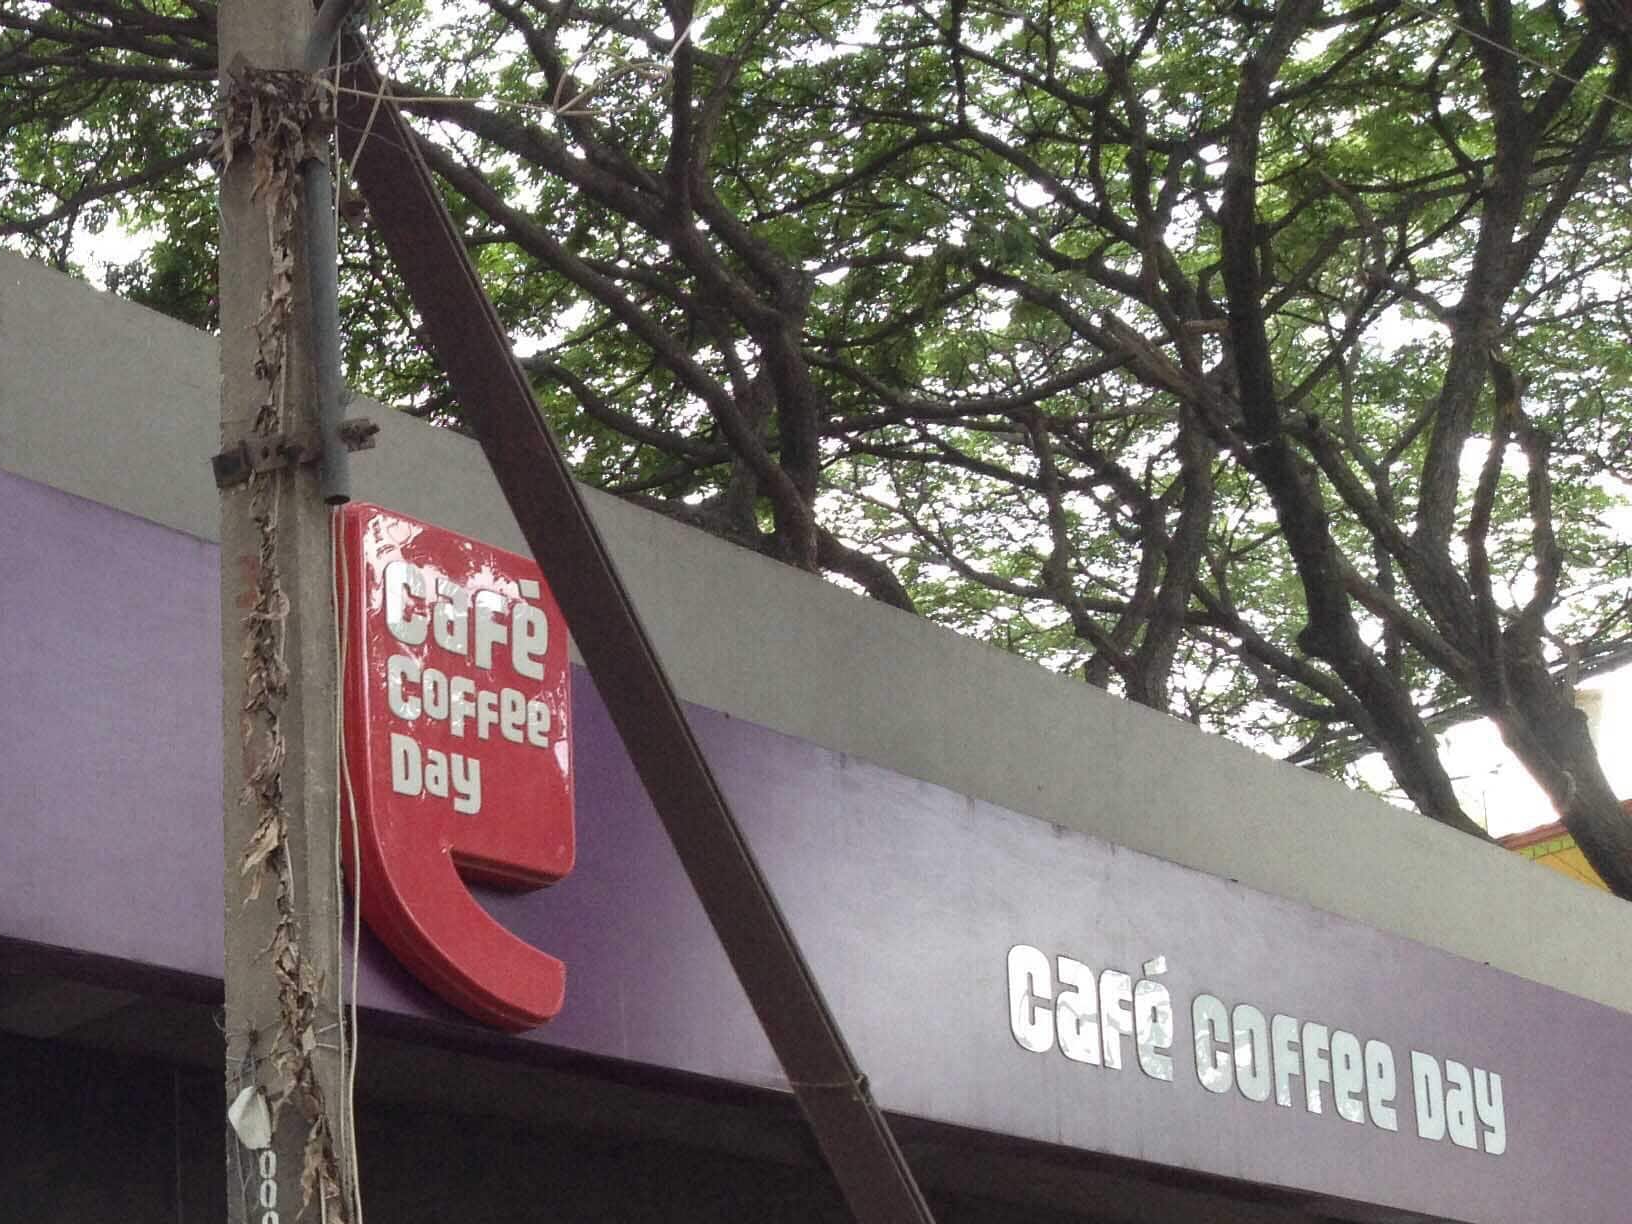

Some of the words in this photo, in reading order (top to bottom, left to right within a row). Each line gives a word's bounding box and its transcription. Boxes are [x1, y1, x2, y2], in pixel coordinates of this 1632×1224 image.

[383, 560, 548, 681] Café
[386, 654, 551, 748] Coffee
[390, 733, 481, 814] Day
[1006, 944, 1173, 1081] Café
[1191, 994, 1398, 1131] Coffee
[1411, 1050, 1506, 1155] Day
